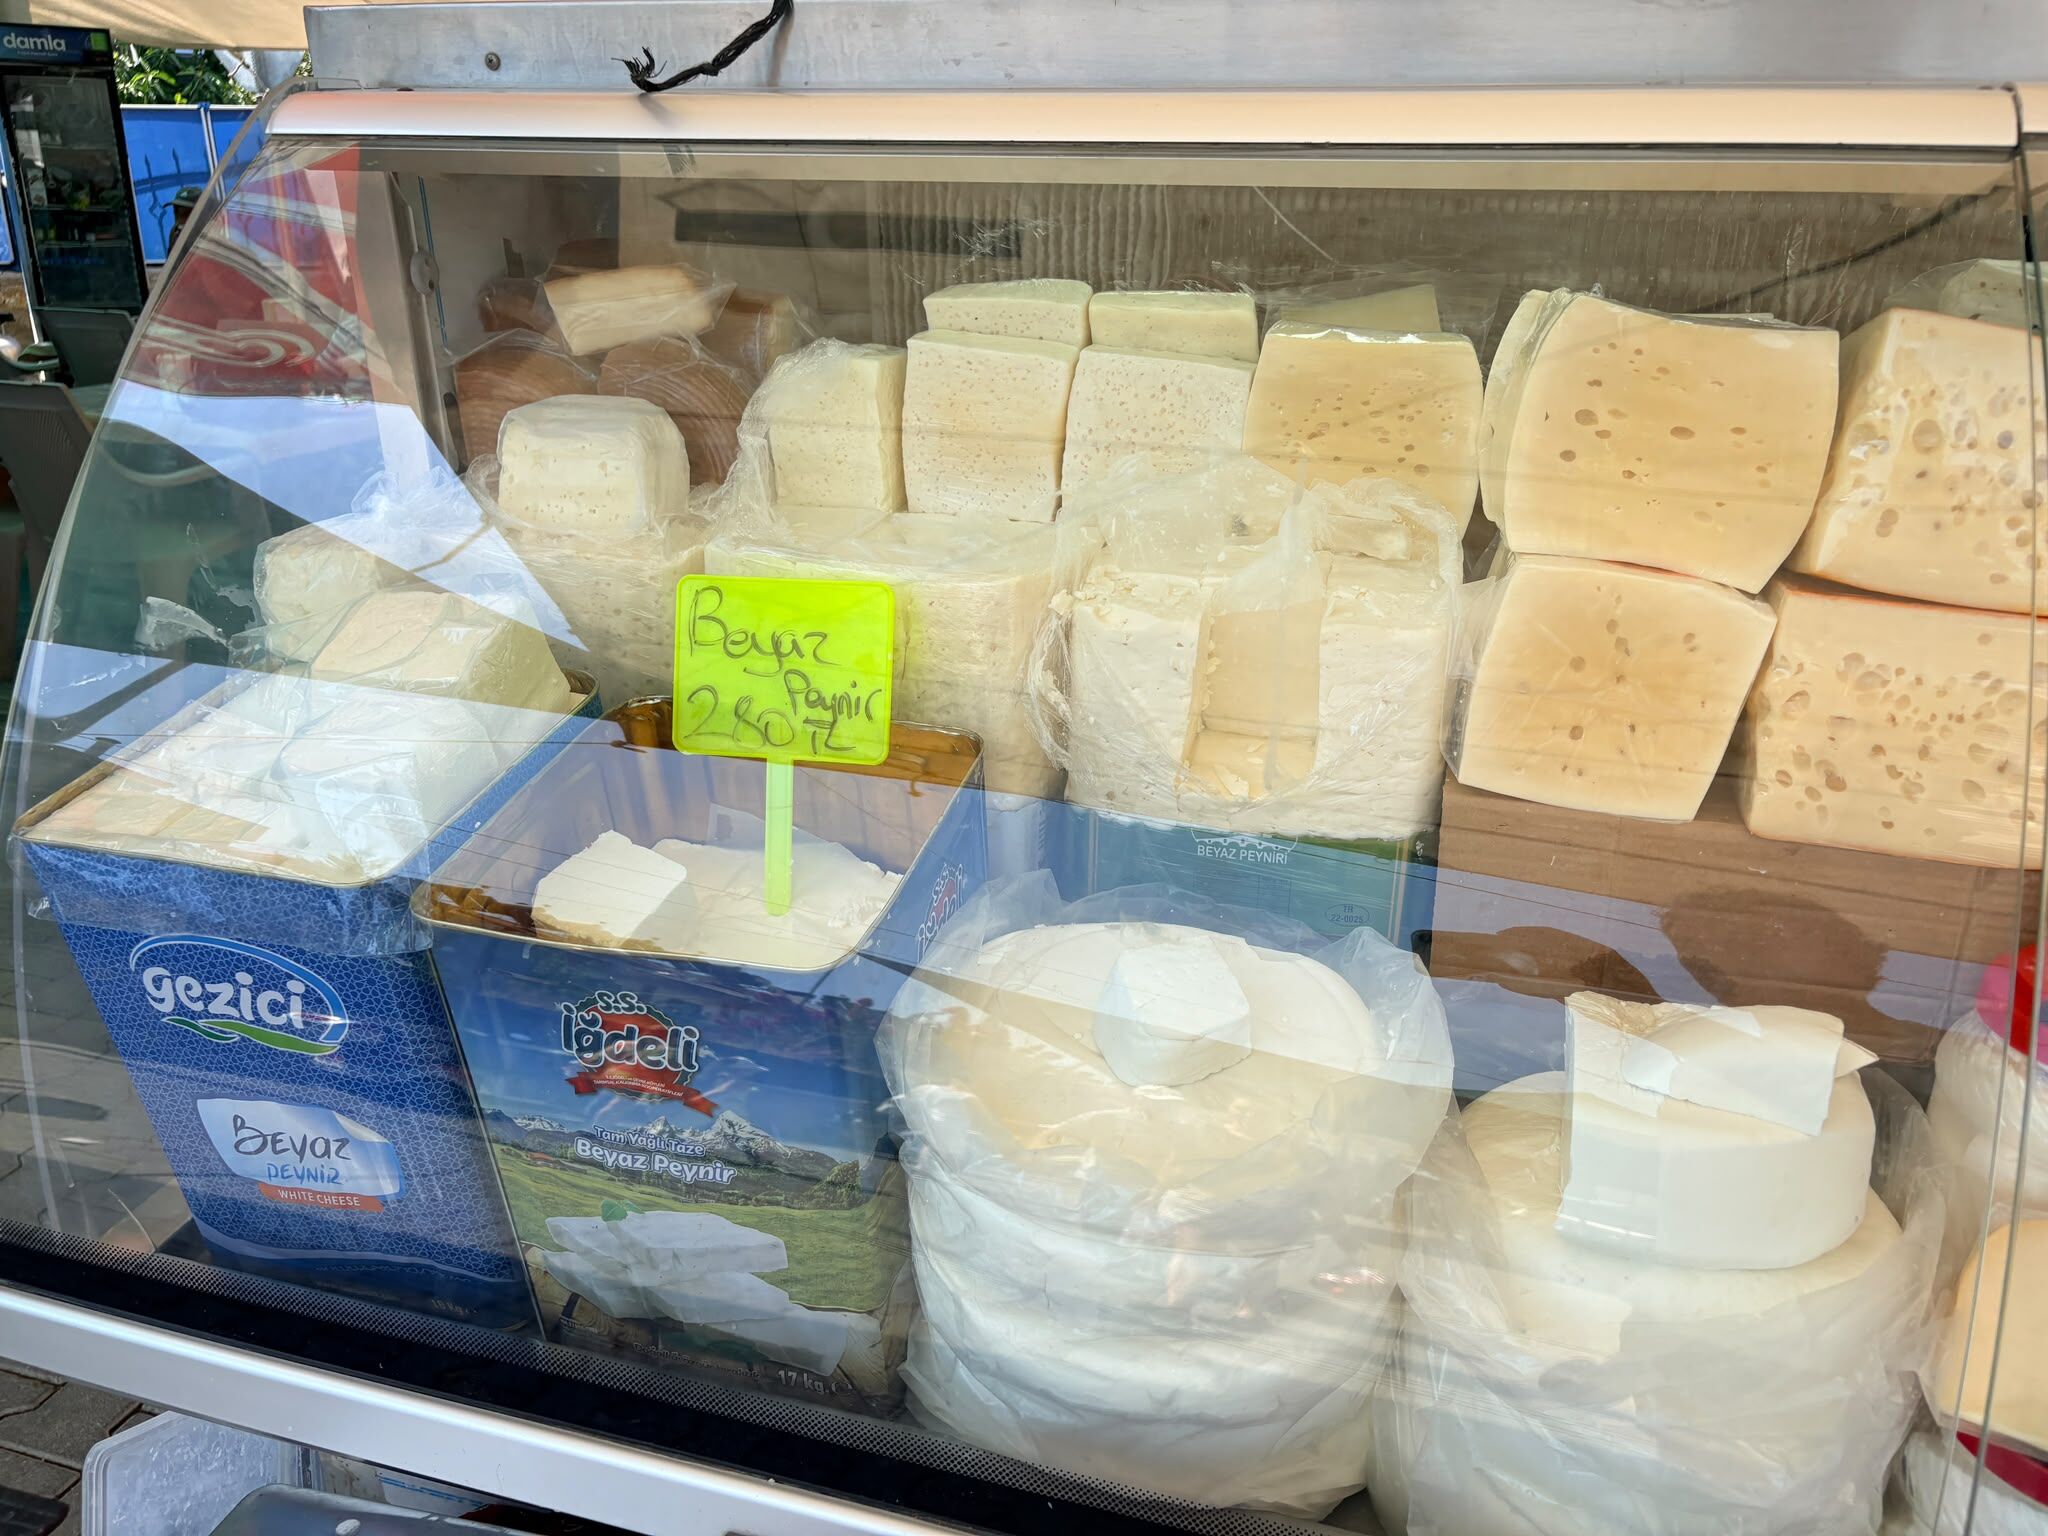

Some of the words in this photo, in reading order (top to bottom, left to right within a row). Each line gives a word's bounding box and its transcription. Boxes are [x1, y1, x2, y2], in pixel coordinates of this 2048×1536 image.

[3, 32, 66, 52] damla
[688, 585, 842, 677] Beyaz
[784, 669, 882, 723] Peynir
[683, 684, 795, 750] 280
[803, 716, 856, 755] TL
[1197, 845, 1237, 860] BEYAZ
[1239, 849, 1288, 865] PEYNİRİ
[143, 967, 305, 1029] gezici
[595, 991, 647, 1014] S.S.
[593, 1125, 625, 1143] Tam
[627, 1132, 667, 1150] Yağlı
[668, 1140, 706, 1157] Taze
[575, 1138, 649, 1170] Beyaz
[650, 1153, 737, 1184] Peynir
[278, 1189, 314, 1202] WHITE
[316, 1194, 360, 1206] CHEESE
[778, 1370, 797, 1386] 17
